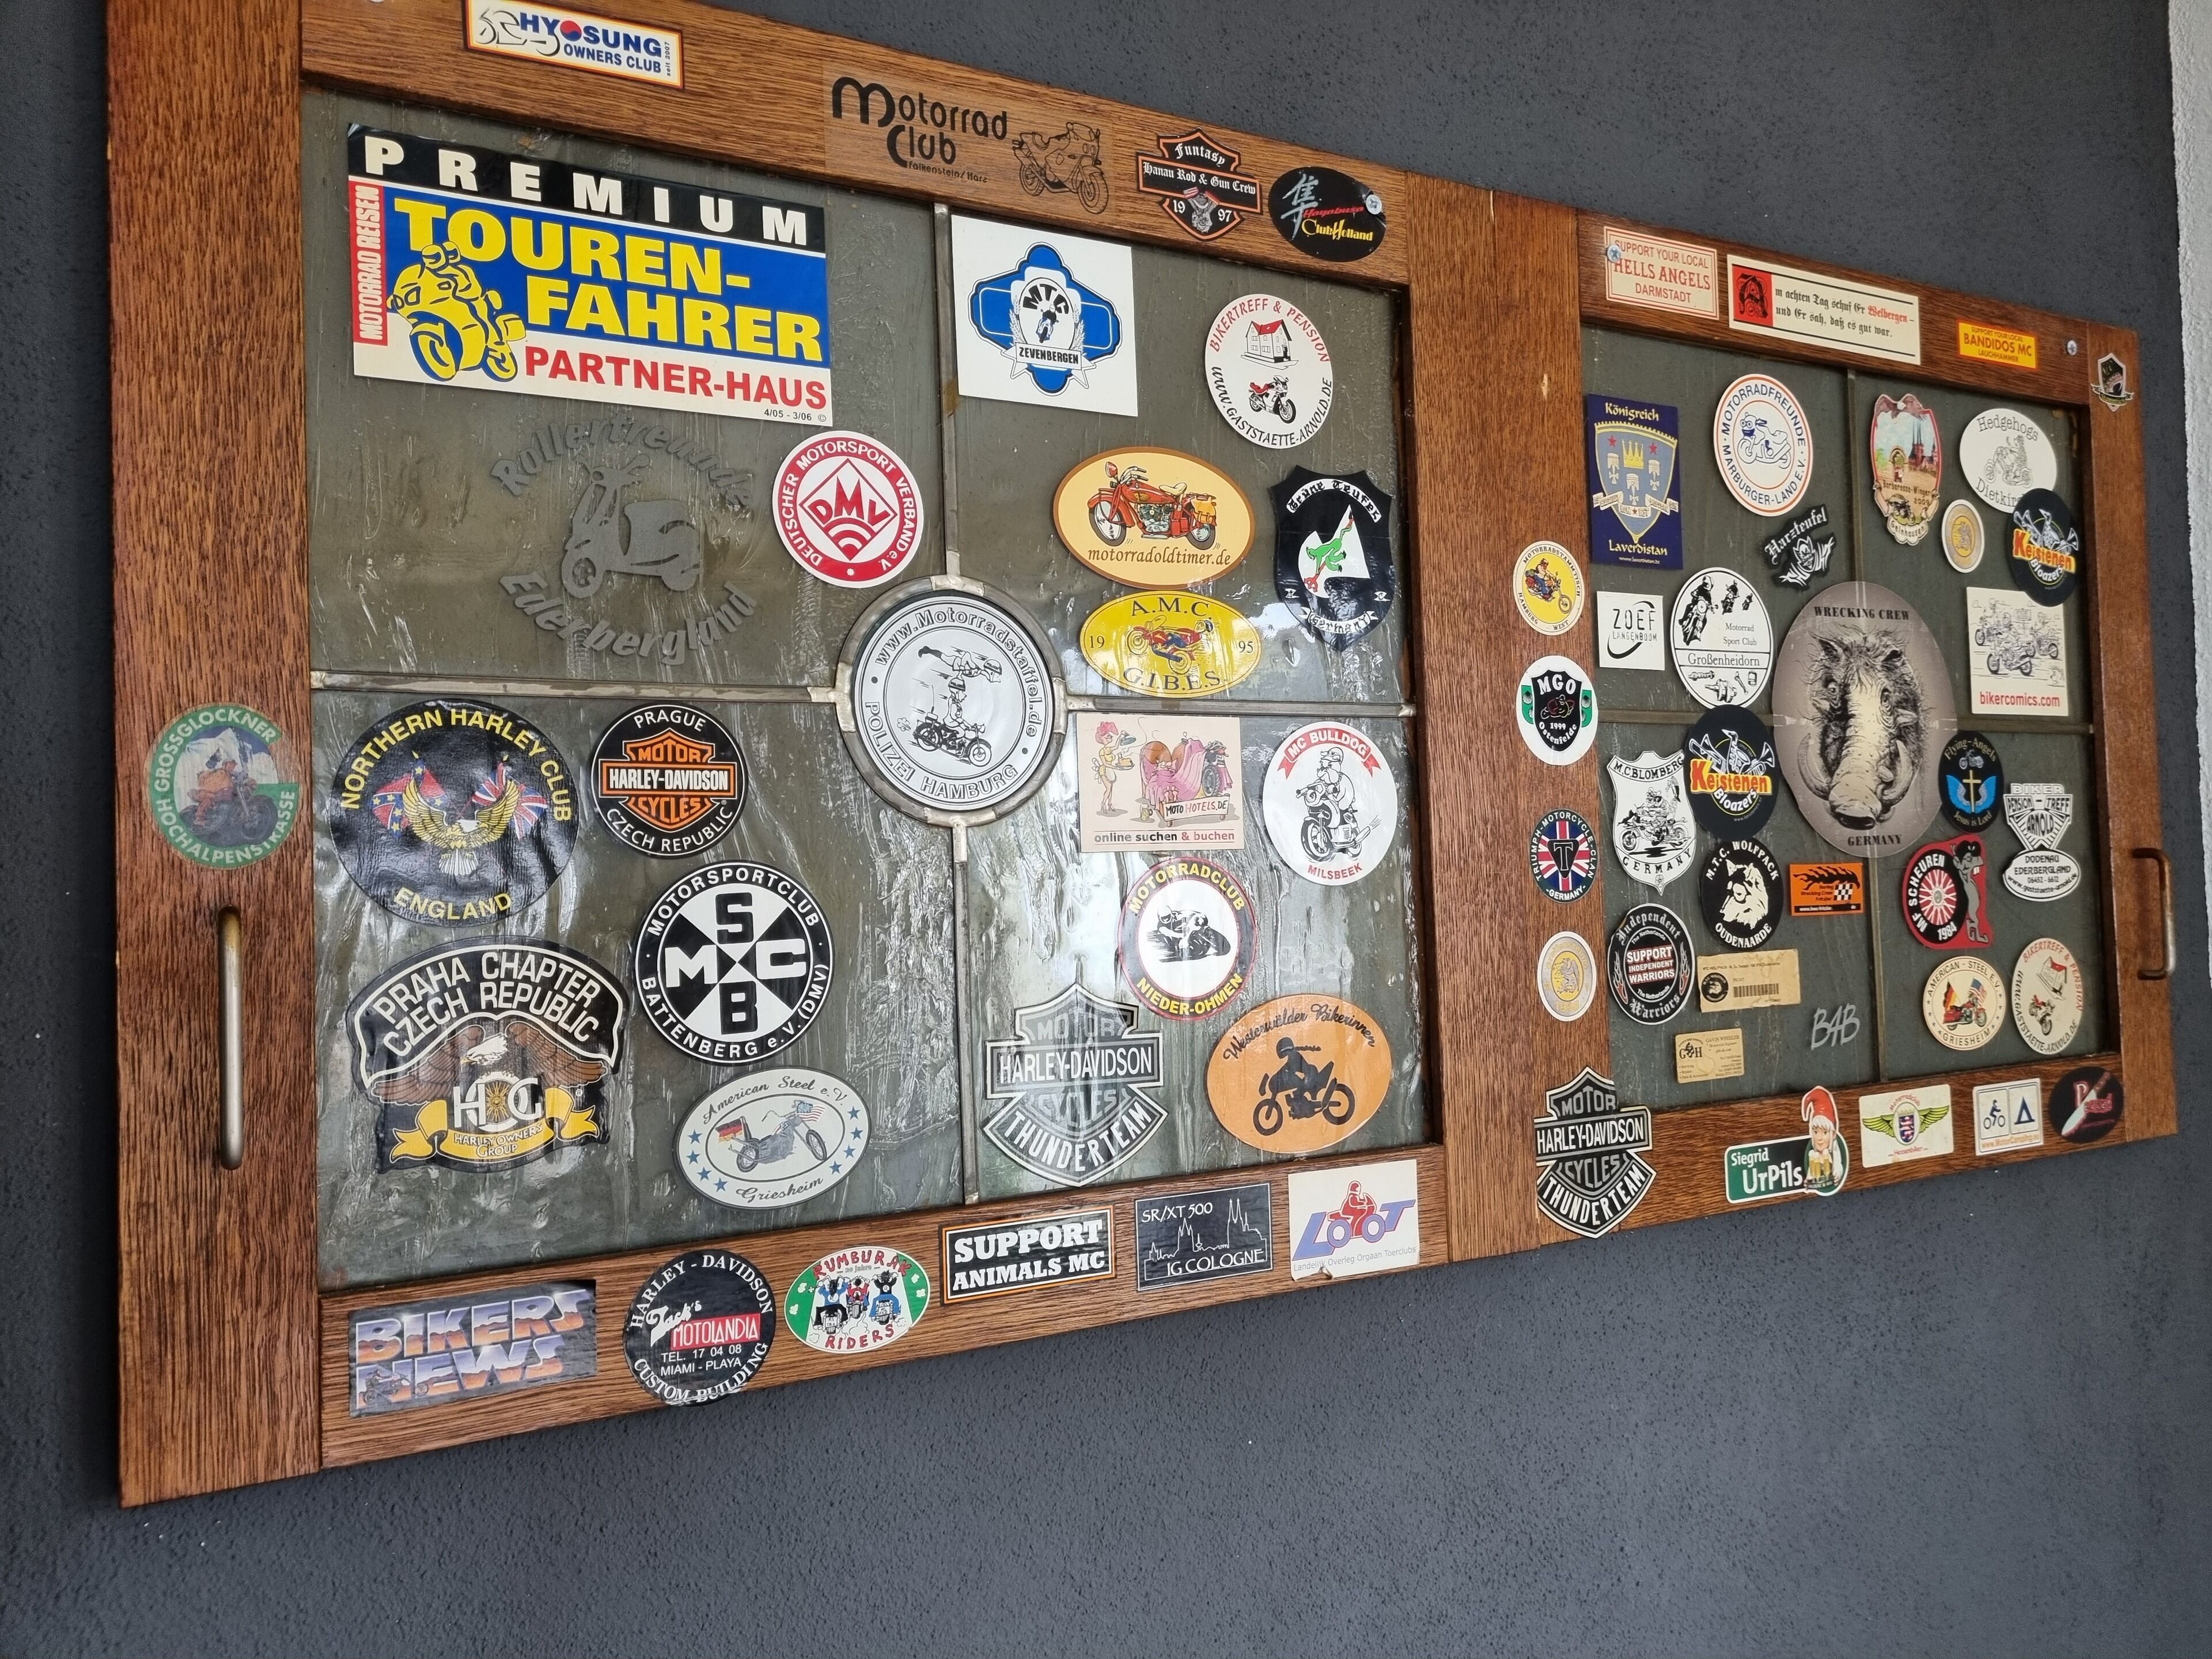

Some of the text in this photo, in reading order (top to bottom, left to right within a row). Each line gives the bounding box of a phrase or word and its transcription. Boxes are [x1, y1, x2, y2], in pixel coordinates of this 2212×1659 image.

[520, 12, 661, 58] HYOSUNG
[564, 43, 661, 74] OWNERS CLUB
[887, 125, 956, 168] Club
[1175, 143, 1225, 167] Funtasy
[365, 137, 807, 246] PREMIUM
[1143, 162, 1256, 195] Hanau Rod & Gun Crew
[1172, 199, 1232, 222] 19 97
[1303, 206, 1365, 218] Hayabusa
[394, 198, 750, 296] TOUREN-
[1615, 240, 1709, 269] SUPPORT YOUR LOCAL
[355, 185, 383, 340] MOTORRAD REISEN
[1613, 257, 1711, 290] HELLS ANGELS
[1635, 282, 1691, 304] DARMSTADT
[1785, 288, 1810, 305] achten
[527, 275, 823, 362] FAHRER
[1210, 298, 1330, 362] BIKERTREFF & PENSION
[1776, 305, 1872, 335] und es gut
[1019, 347, 1078, 364] ZEVENBERGEN
[1963, 333, 2032, 357] BANDIDOS MC
[525, 346, 827, 410] PARTNER-HAUS
[1211, 366, 1332, 446] www.GASTSTAETTE-ARNOLD.DE
[1605, 402, 1660, 422] Königreich
[1721, 383, 1806, 447] MOTORRADFREUNDE
[1976, 414, 2039, 441] Hedgehogs
[782, 441, 916, 566] DEUTSCHER MOTORSPORT VERBAND
[808, 475, 891, 527] DMV
[1088, 547, 1231, 566] motorradoldtimer.de
[1608, 539, 1668, 556] Laverdistan
[499, 571, 757, 665] Ederbergland
[1553, 619, 1569, 631] WEST
[1612, 608, 1656, 631] ZOEF
[1725, 622, 1755, 632] Motorrad
[1814, 606, 1910, 621] WRECKING CREW
[1089, 635, 1254, 653] 19 95
[1723, 637, 1758, 646] Sport Club
[874, 608, 1043, 738] www.Motorradstaffel.de
[1688, 652, 1760, 666] Großenheidorn
[1536, 673, 1576, 695] MGO
[1979, 691, 2061, 707] bikercomics.com
[634, 710, 706, 732] PRAGUE
[1539, 721, 1577, 745] Ostenfelde
[1550, 722, 1566, 730] 1999
[154, 709, 276, 792] GROSSGLOCKNER
[638, 738, 701, 762] MOTOR
[865, 702, 1018, 800] POLIZEI HAMBURG
[1288, 729, 1367, 759] MC BULLDOG
[340, 709, 571, 822] NORTHERN HARLEY CLUB
[609, 768, 728, 790] HARLEY-DAVIDSON
[2012, 784, 2064, 794] BIKER
[638, 797, 701, 823] CYCLES
[2047, 797, 2070, 813] TREFF
[607, 806, 733, 852] CZECH REPUBLIC
[1094, 831, 1234, 842] online suchen & buchen
[2027, 812, 2055, 835] ARNOLD
[1532, 812, 1597, 882] TRIUMPH-MOTORCYCLE-CLAN
[1847, 834, 1903, 847] GERMANY
[1307, 862, 1363, 880] MILSBEEK
[1623, 848, 1691, 874] GERMANY
[1732, 840, 1779, 881] WOLFPACK
[2014, 866, 2071, 876] EDERBERGLAND
[2025, 854, 2059, 863] DODENAU
[647, 868, 820, 936] MOTORSPORTCLUB
[1128, 863, 1245, 914] MOTORRADCLUB
[1908, 854, 1957, 941] SCHEUREN 1984
[394, 887, 512, 920] ENGLAND
[1615, 912, 1681, 946] Independent
[1715, 923, 1772, 948] OUDENAARDE
[1626, 946, 1673, 963] SUPPORT
[1628, 960, 1673, 972] INDEPENDENT
[2023, 940, 2065, 963] BIKERTREFF
[373, 952, 601, 1025] PRAHA CHAPTER
[1629, 969, 1675, 984] WARRIORS
[1927, 960, 1988, 997] AMERICAN STEEL
[1136, 972, 1243, 1016] NIEDER-OHMEN
[1629, 994, 1680, 1019] Warriors
[383, 980, 599, 1057] CZECH REPUBLIC
[642, 963, 830, 1058] BATTENBERG (DMV)
[1310, 1003, 1376, 1047] Bikerinnen
[1943, 1028, 1991, 1047] GRIESHEIM
[1000, 1046, 1152, 1084] HARLEY-DAVIDSON
[703, 1076, 815, 1124] American Steel
[1562, 1085, 1616, 1116] MOTOR
[454, 1123, 543, 1146] HARLEY OWNERS
[1537, 1116, 1644, 1154] HARLEY-DAVIDSON
[475, 1143, 518, 1158] GROUP
[1730, 1147, 1770, 1168] Siegrid
[1565, 1154, 1621, 1189] CYCLES
[1742, 1161, 1804, 1194] UrPils
[736, 1177, 823, 1203] Griesheim
[1141, 1202, 1213, 1223] SR/XT 500
[954, 1219, 1103, 1263] SUPPORT
[812, 1250, 912, 1280] RUMBURAK
[953, 1251, 1105, 1290] ANIMALS MC
[1167, 1248, 1265, 1277] IG COLOGNE
[1294, 1246, 1416, 1272] Landelijk Overleg Orgaan Toerclubs
[630, 1255, 772, 1328] HARLEY DAVIDSON
[355, 1289, 591, 1364] BIKERS
[673, 1316, 759, 1348] MOTOLANDIA
[825, 1324, 894, 1350] RIDERS
[661, 1344, 742, 1362] TEL. 17 04 08
[661, 1357, 741, 1376] MIAMI PLAYA
[356, 1334, 566, 1409] NEWS
[634, 1342, 768, 1403] CUSTOM BUILDING
